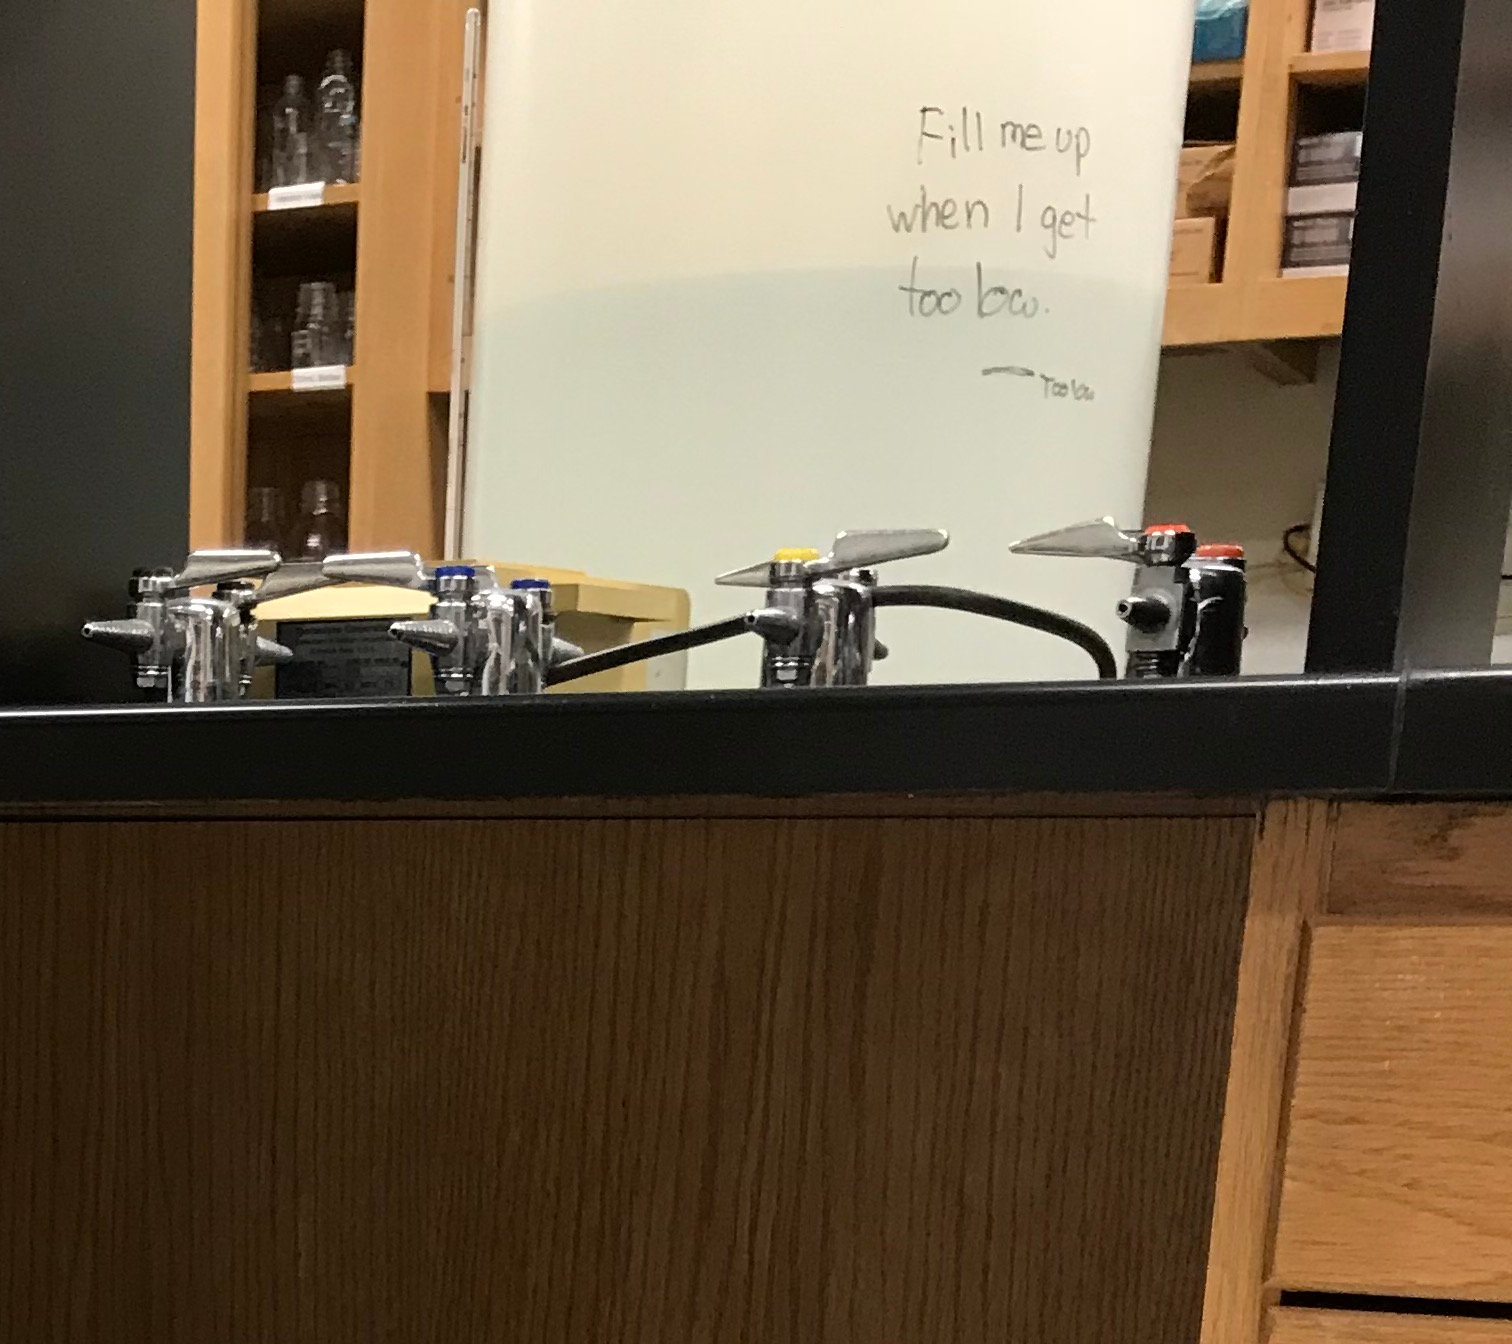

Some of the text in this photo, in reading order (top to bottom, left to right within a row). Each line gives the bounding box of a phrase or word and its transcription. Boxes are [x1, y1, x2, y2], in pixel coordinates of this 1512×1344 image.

[917, 105, 1091, 176] Fill me up
[886, 183, 1097, 259] when I get
[898, 255, 962, 317] too
